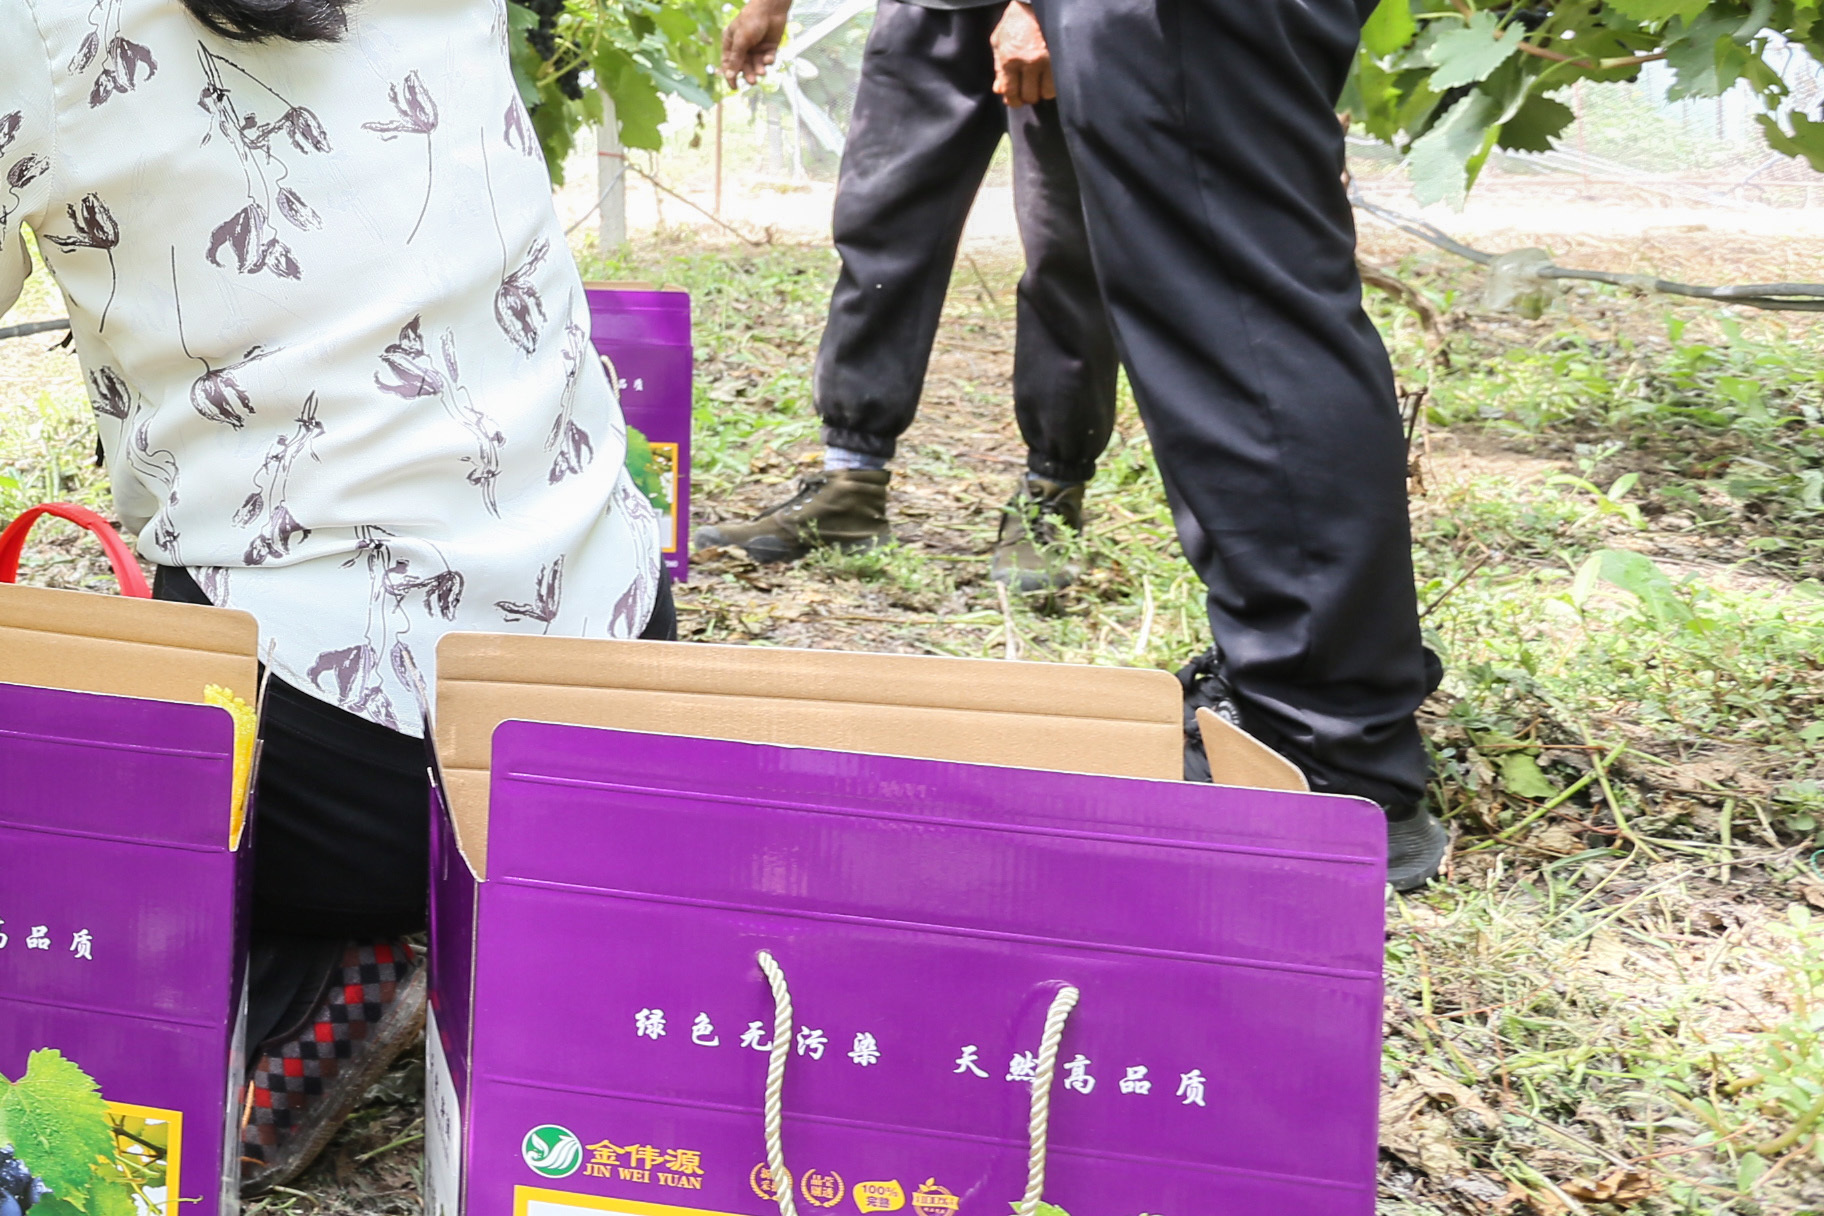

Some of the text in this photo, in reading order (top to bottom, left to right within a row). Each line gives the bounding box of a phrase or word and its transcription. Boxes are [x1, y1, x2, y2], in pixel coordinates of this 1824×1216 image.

[634, 1007, 1207, 1107] 绿色无污染 天然高品质
[584, 1139, 705, 1175] 金伟源
[582, 1163, 702, 1189] JIN WEI YUAN
[862, 1185, 898, 1199] 100%
